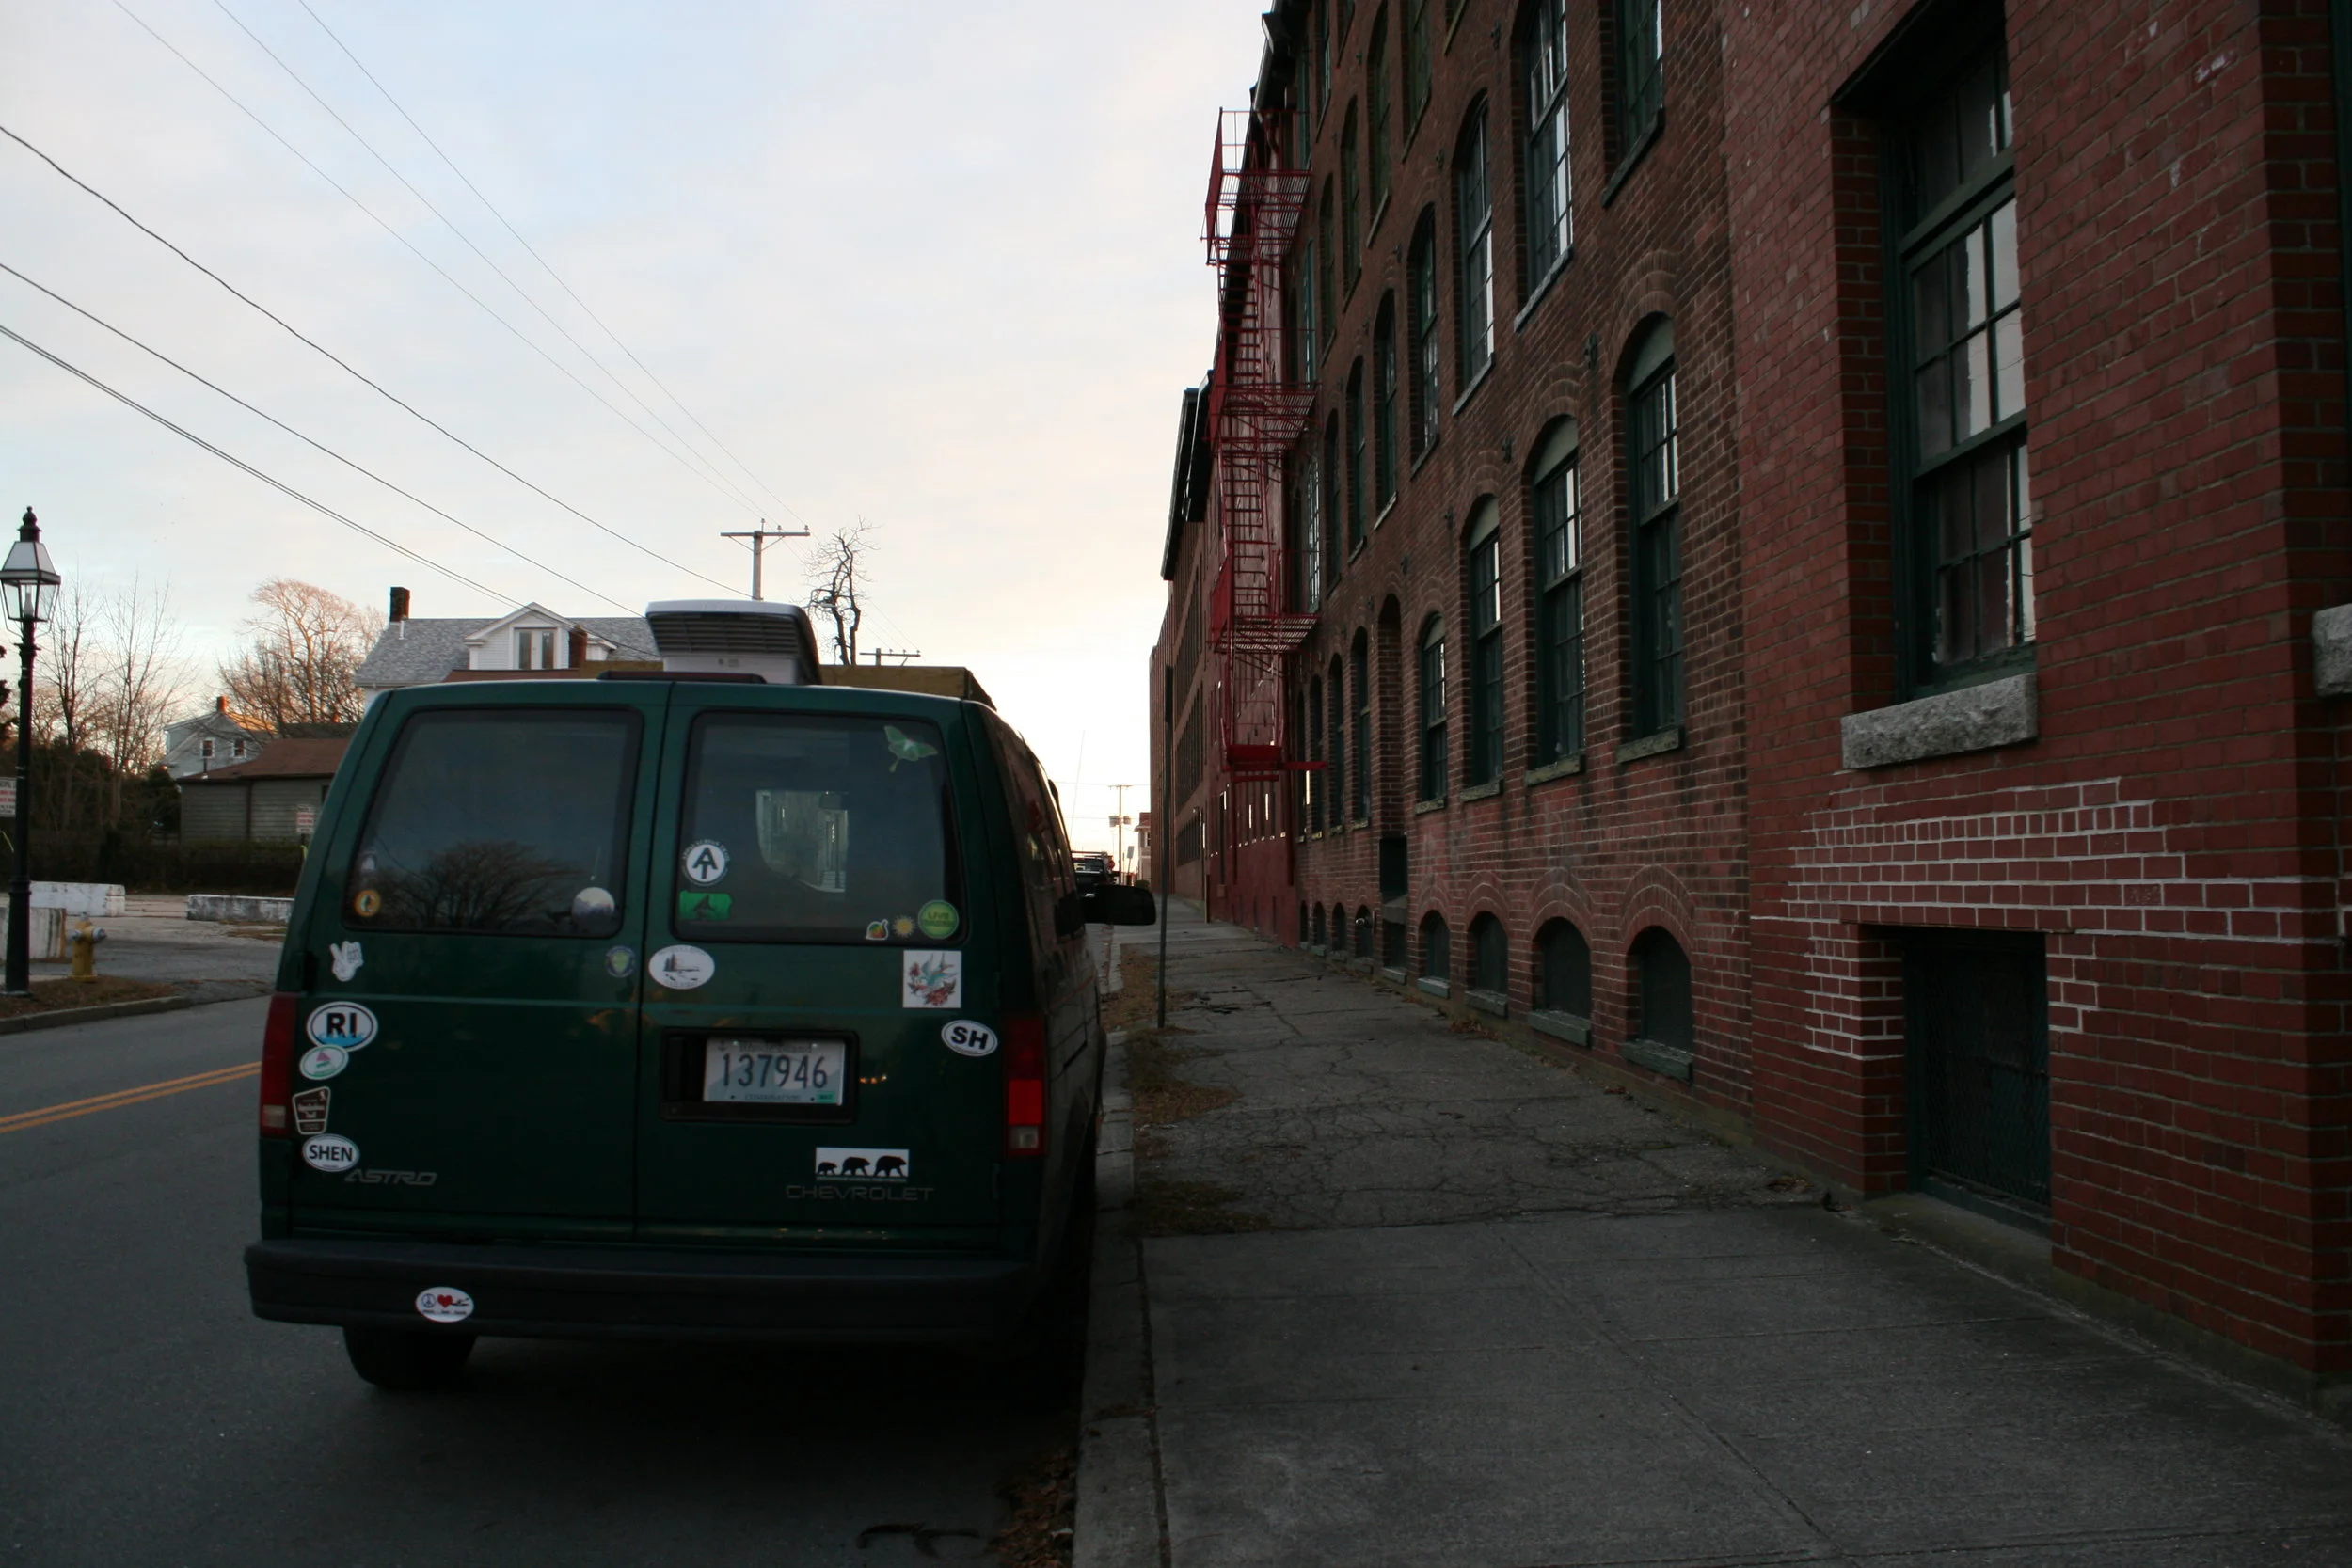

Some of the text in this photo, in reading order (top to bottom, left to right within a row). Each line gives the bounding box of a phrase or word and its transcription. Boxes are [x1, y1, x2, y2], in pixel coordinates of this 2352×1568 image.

[326, 1012, 357, 1039] RI
[951, 1026, 989, 1050] SH
[723, 1053, 828, 1089] 137946
[309, 1144, 353, 1162] SHEN
[344, 1168, 438, 1186] ASTRO
[786, 1184, 935, 1201] CHEVROLET
